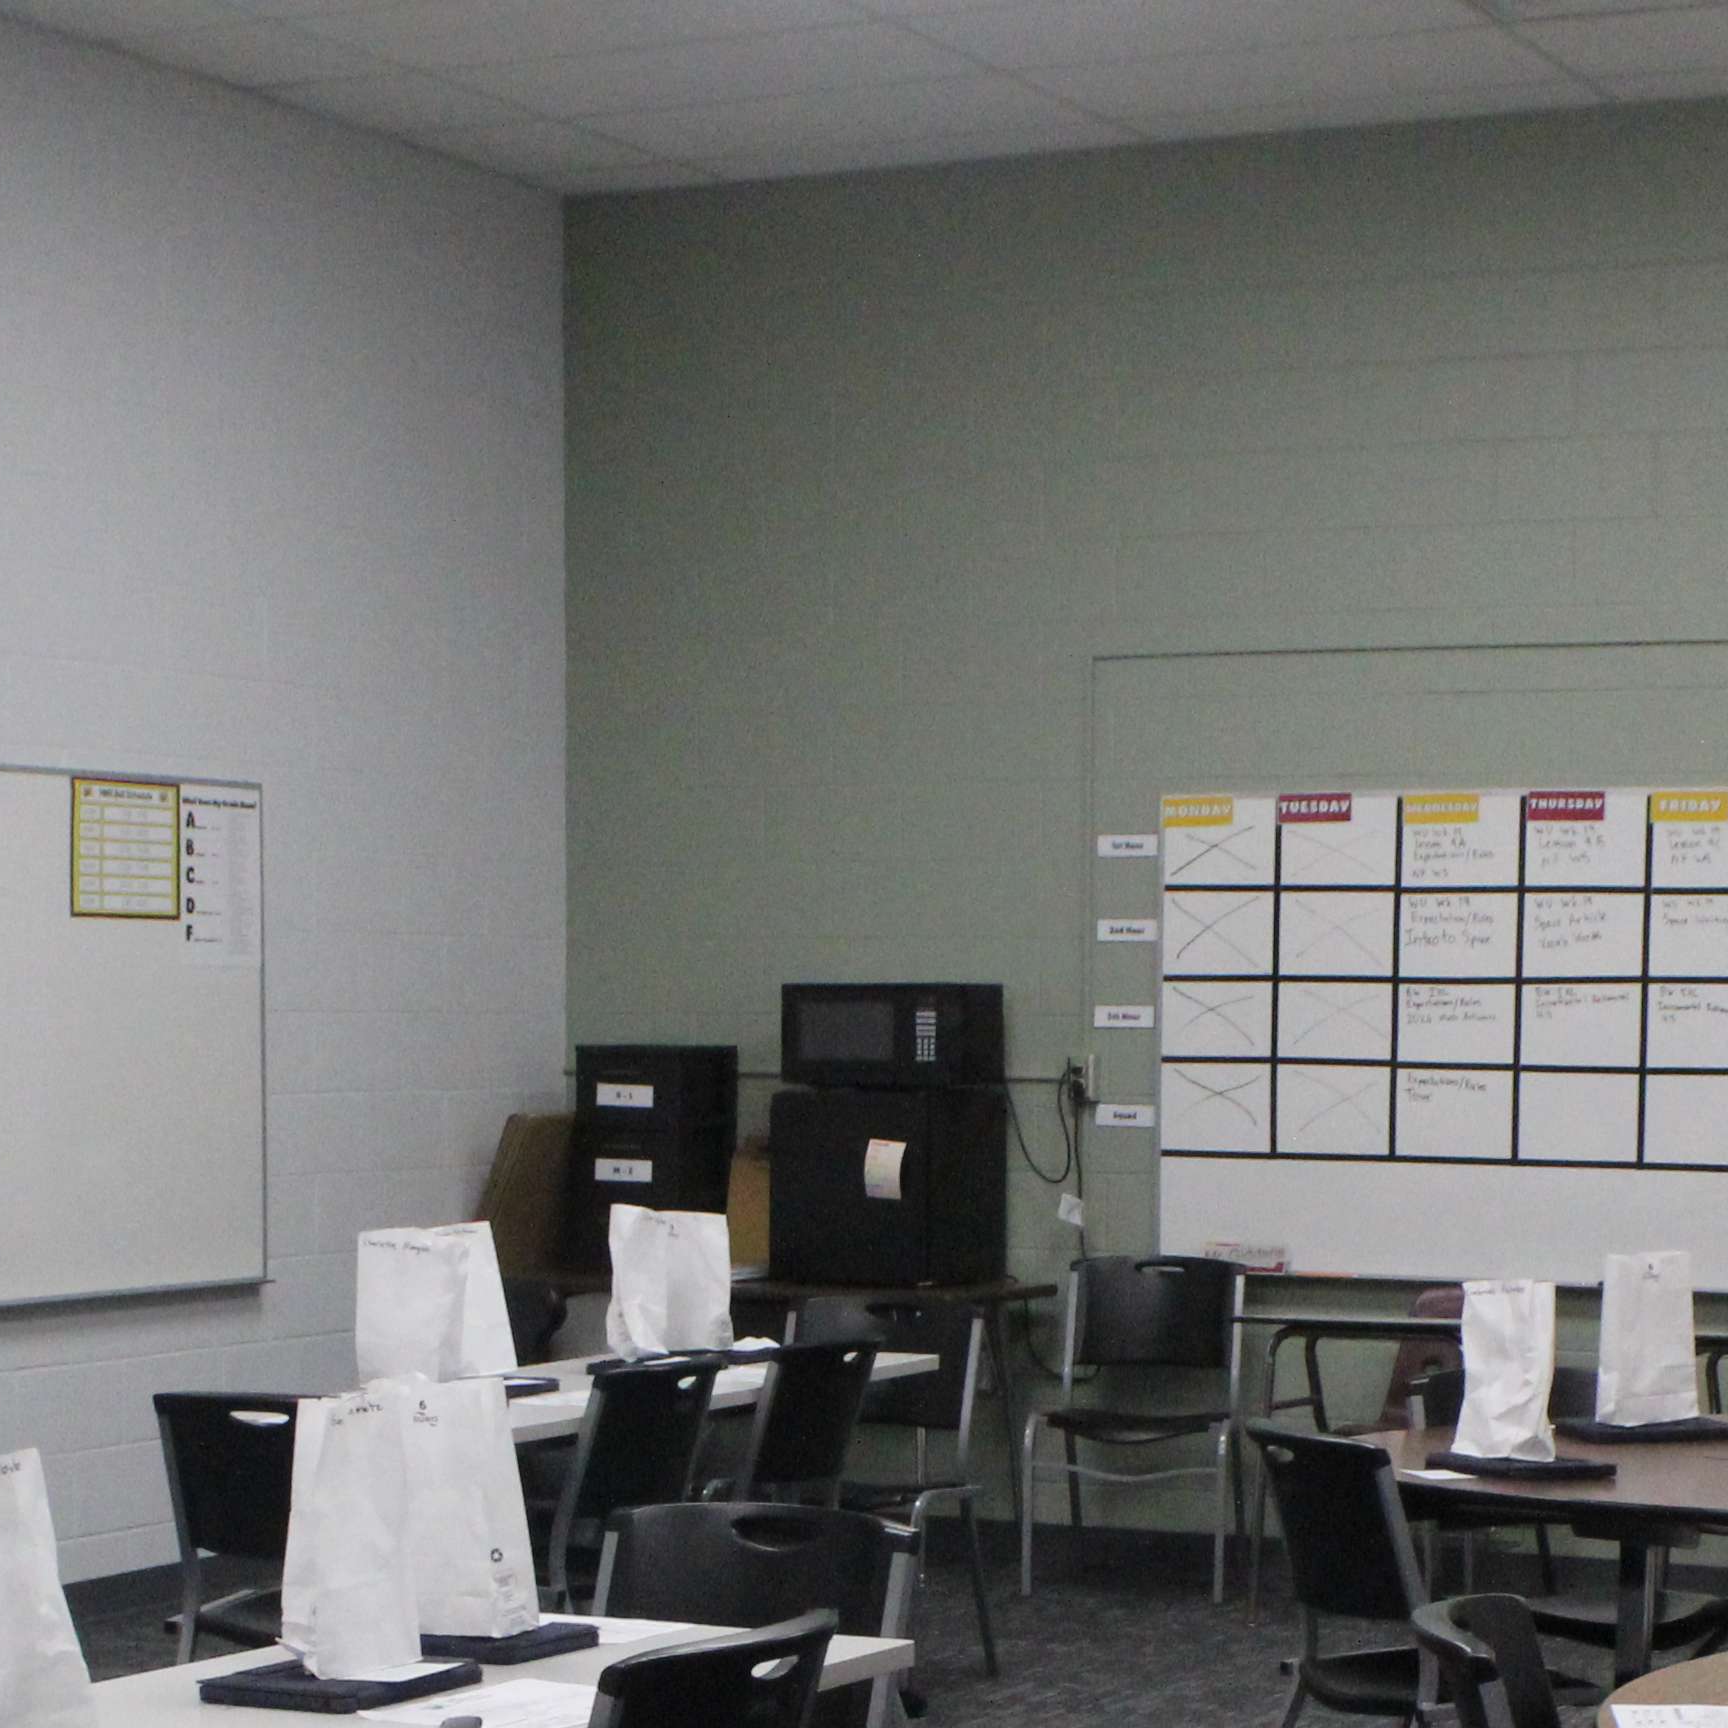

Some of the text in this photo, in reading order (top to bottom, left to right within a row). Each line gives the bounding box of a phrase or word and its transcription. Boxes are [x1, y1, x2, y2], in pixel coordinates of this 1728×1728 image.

[1165, 804, 1232, 817] MONDAY
[1280, 800, 1351, 815] TUESDAY
[1530, 797, 1603, 810] THURSDAY
[1659, 799, 1722, 813] FRIDAY
[186, 811, 195, 829] A
[186, 839, 194, 856] B
[186, 867, 195, 884] C
[186, 897, 195, 914] D
[186, 924, 193, 941] F
